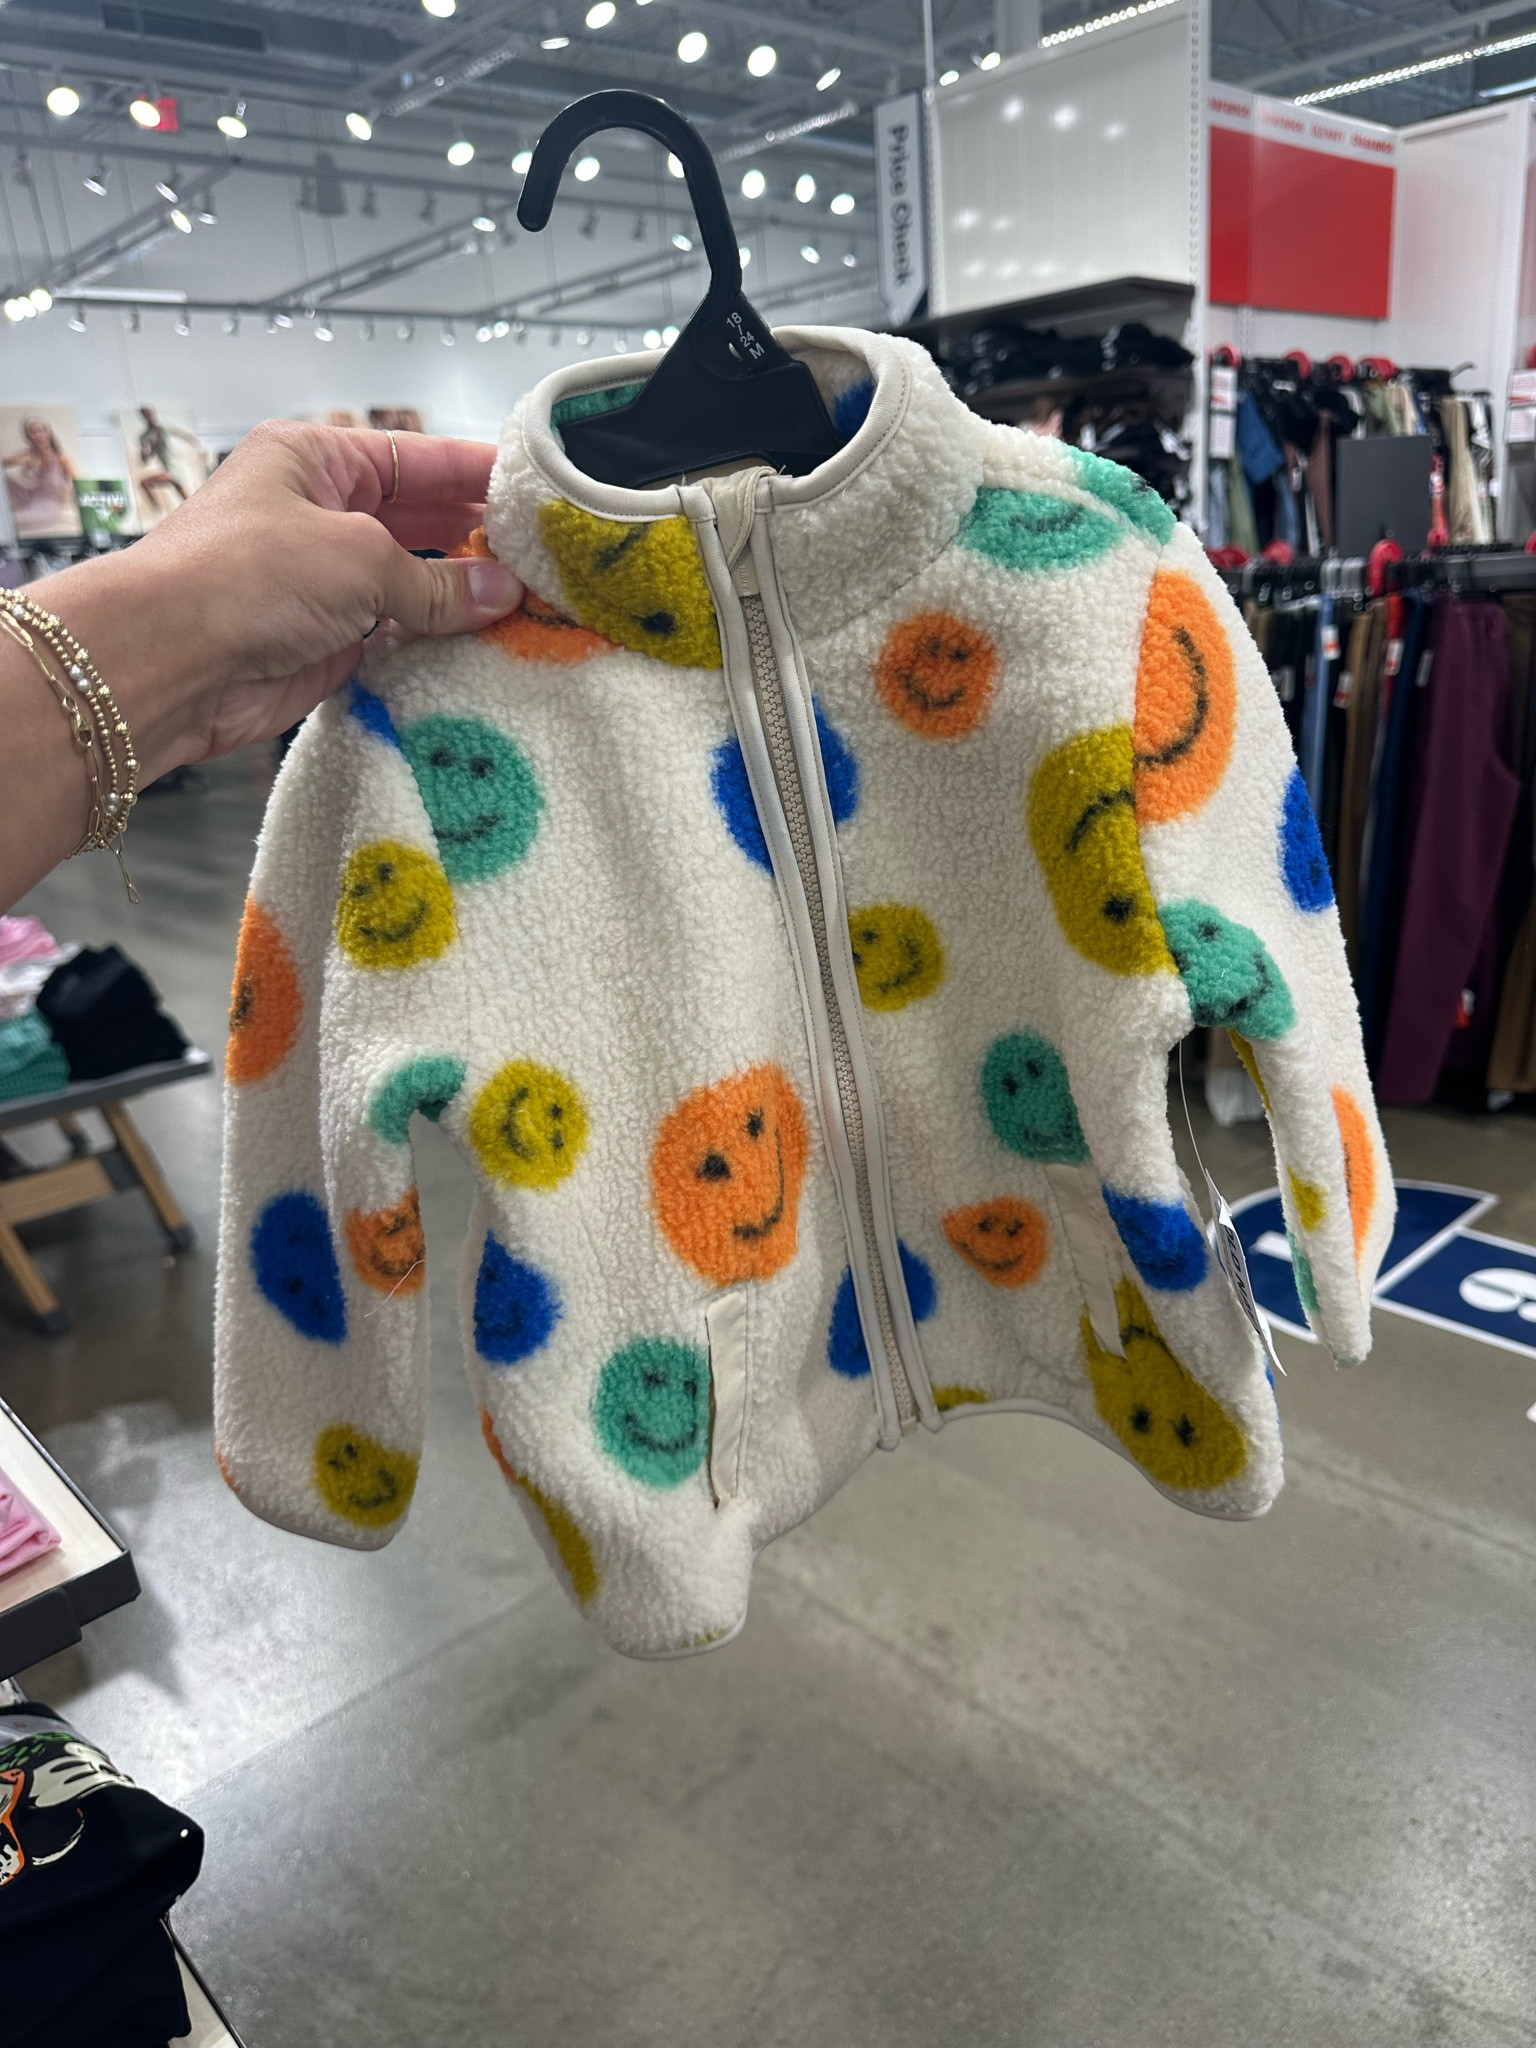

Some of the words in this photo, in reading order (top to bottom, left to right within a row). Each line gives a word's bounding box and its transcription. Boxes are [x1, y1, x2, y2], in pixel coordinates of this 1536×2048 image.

[726, 312, 742, 328] 18
[740, 331, 755, 348] 24
[749, 342, 765, 360] M
